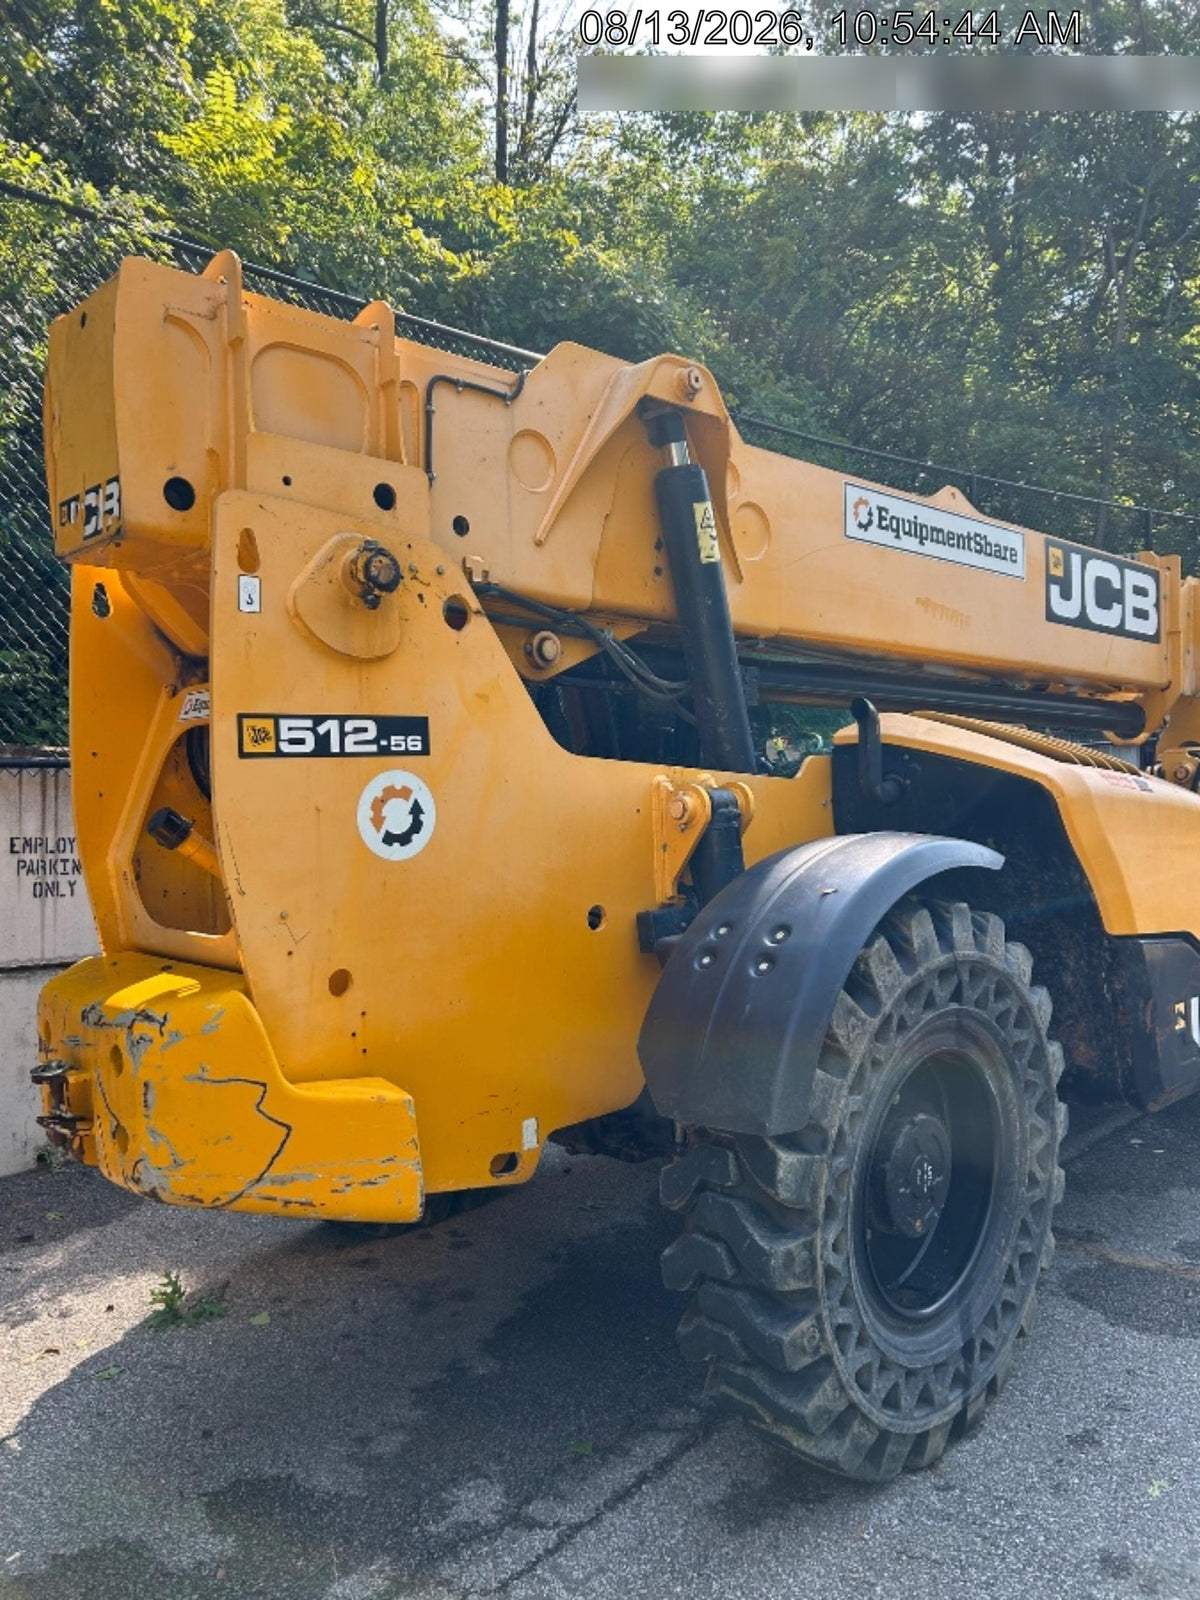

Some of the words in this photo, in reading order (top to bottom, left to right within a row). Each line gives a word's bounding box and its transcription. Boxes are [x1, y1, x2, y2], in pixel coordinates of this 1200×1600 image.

[876, 504, 1018, 564] EquipmentShare
[1050, 552, 1159, 635] JCB
[278, 718, 422, 753] 512-56
[17, 858, 82, 877] PARKIN
[33, 880, 77, 898] ONLY
